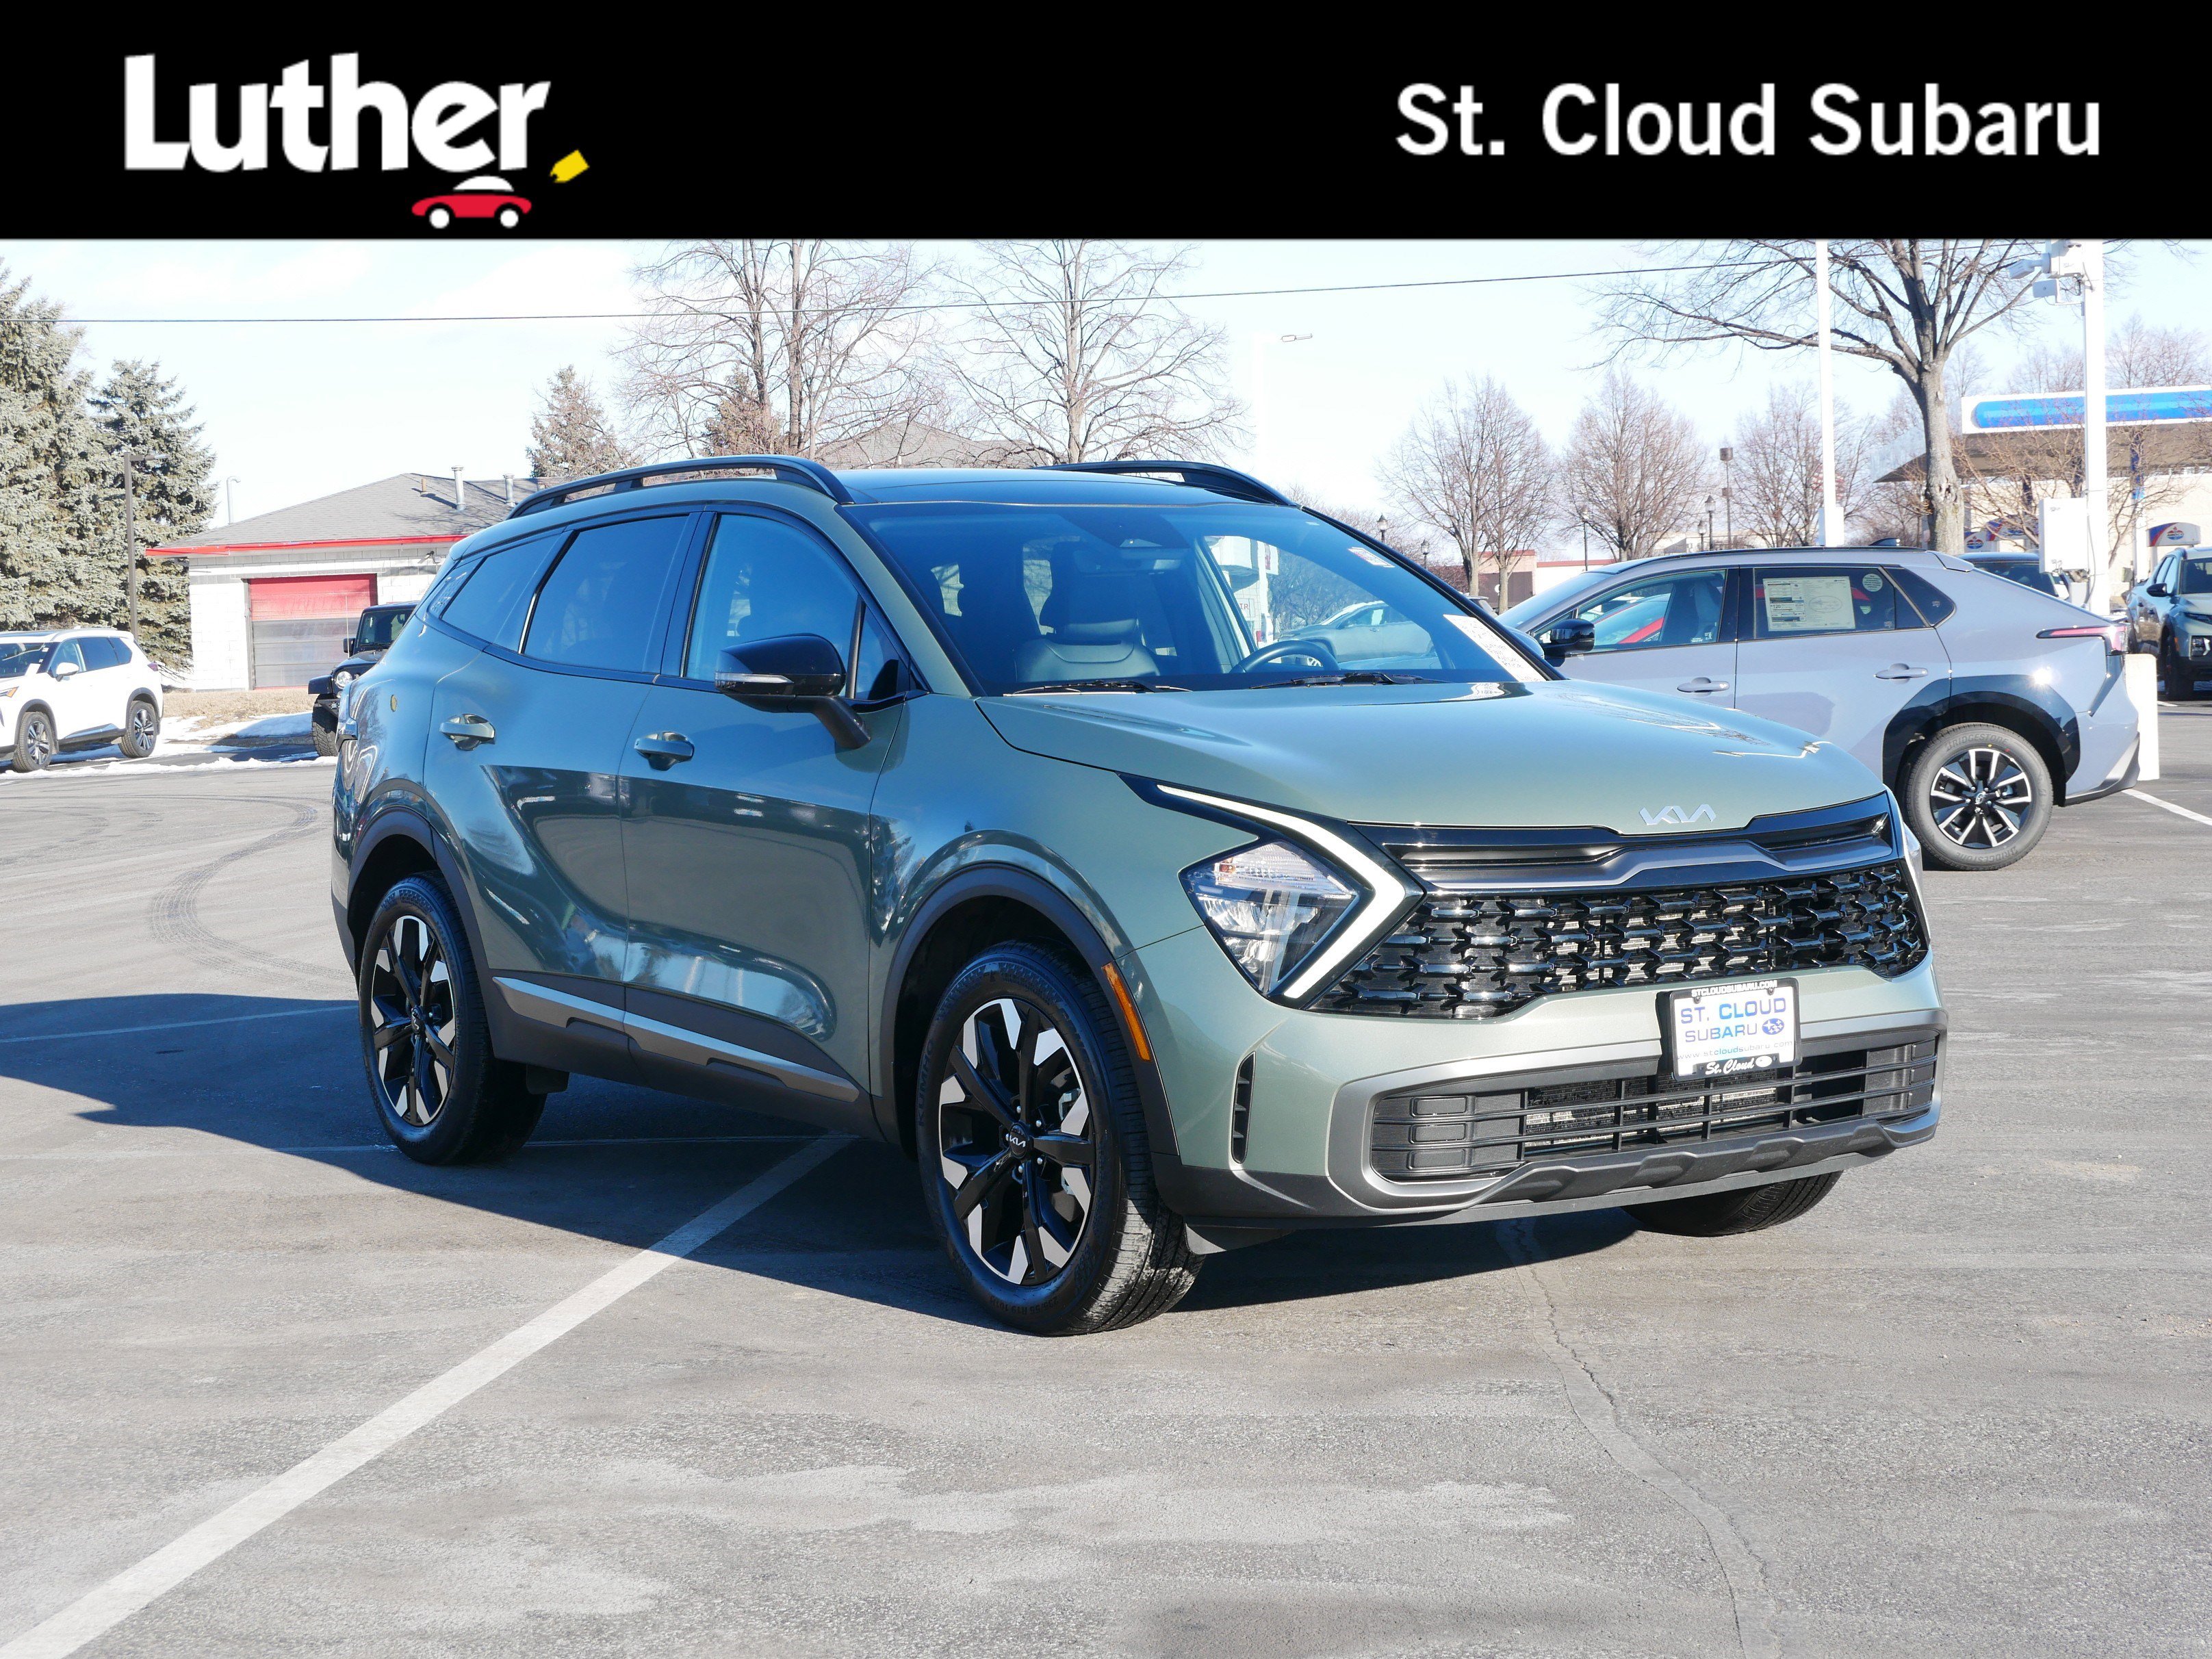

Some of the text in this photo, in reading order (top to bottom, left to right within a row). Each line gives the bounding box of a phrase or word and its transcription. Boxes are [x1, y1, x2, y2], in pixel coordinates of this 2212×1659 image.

[1946, 733, 2009, 751] BRIDGESTONE
[1638, 803, 1716, 825] KIA
[1692, 981, 1777, 997] STCLOUDSUBARU.COM
[1681, 997, 1786, 1025] ST. CLOUD
[1685, 1023, 1758, 1042] SUBARU
[1677, 1041, 1793, 1060] wwwstcloudsubarucom
[1706, 1058, 1755, 1075] St. Cloud
[1009, 1135, 1026, 1148] KIA
